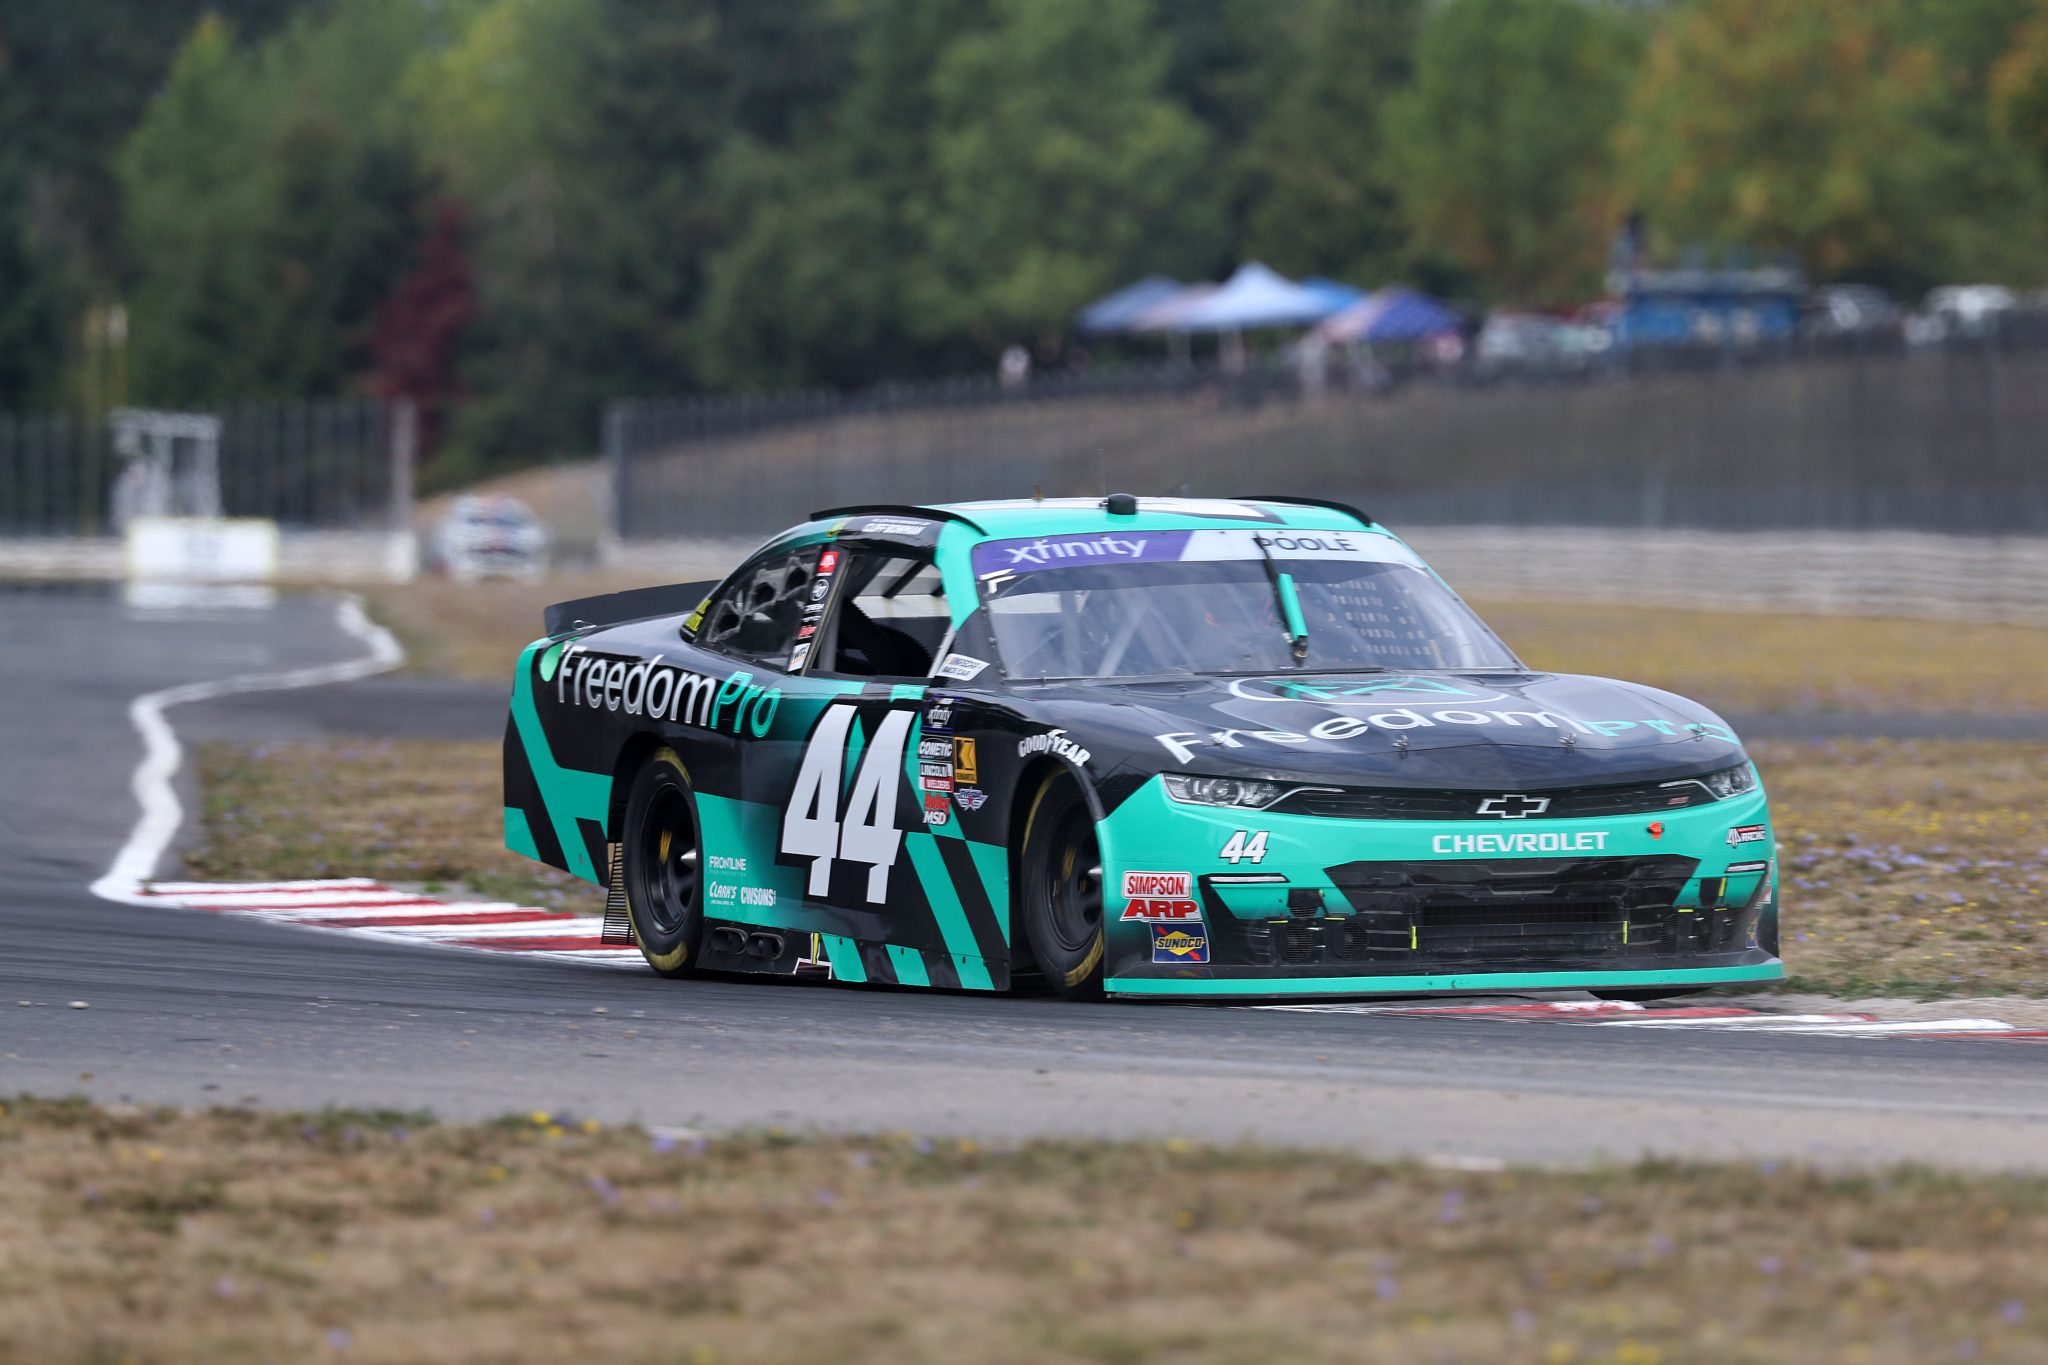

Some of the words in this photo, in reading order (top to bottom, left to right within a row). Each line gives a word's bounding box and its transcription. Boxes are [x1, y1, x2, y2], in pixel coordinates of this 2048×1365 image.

[1004, 536, 1148, 564] xfinity
[1252, 537, 1359, 552] POOLE
[919, 741, 953, 757] COMETIC
[1018, 729, 1091, 767] GOODYEAR
[920, 764, 949, 777] LINCOLN
[781, 704, 902, 904] 44
[923, 811, 947, 825] MSD
[1219, 830, 1270, 864] 44
[1432, 831, 1610, 853] CHEVROLET
[709, 855, 747, 871] FRONTLINE
[1127, 876, 1185, 896] SIMPSON
[1124, 900, 1198, 918] ARP
[1158, 938, 1202, 948] SUNOCO
